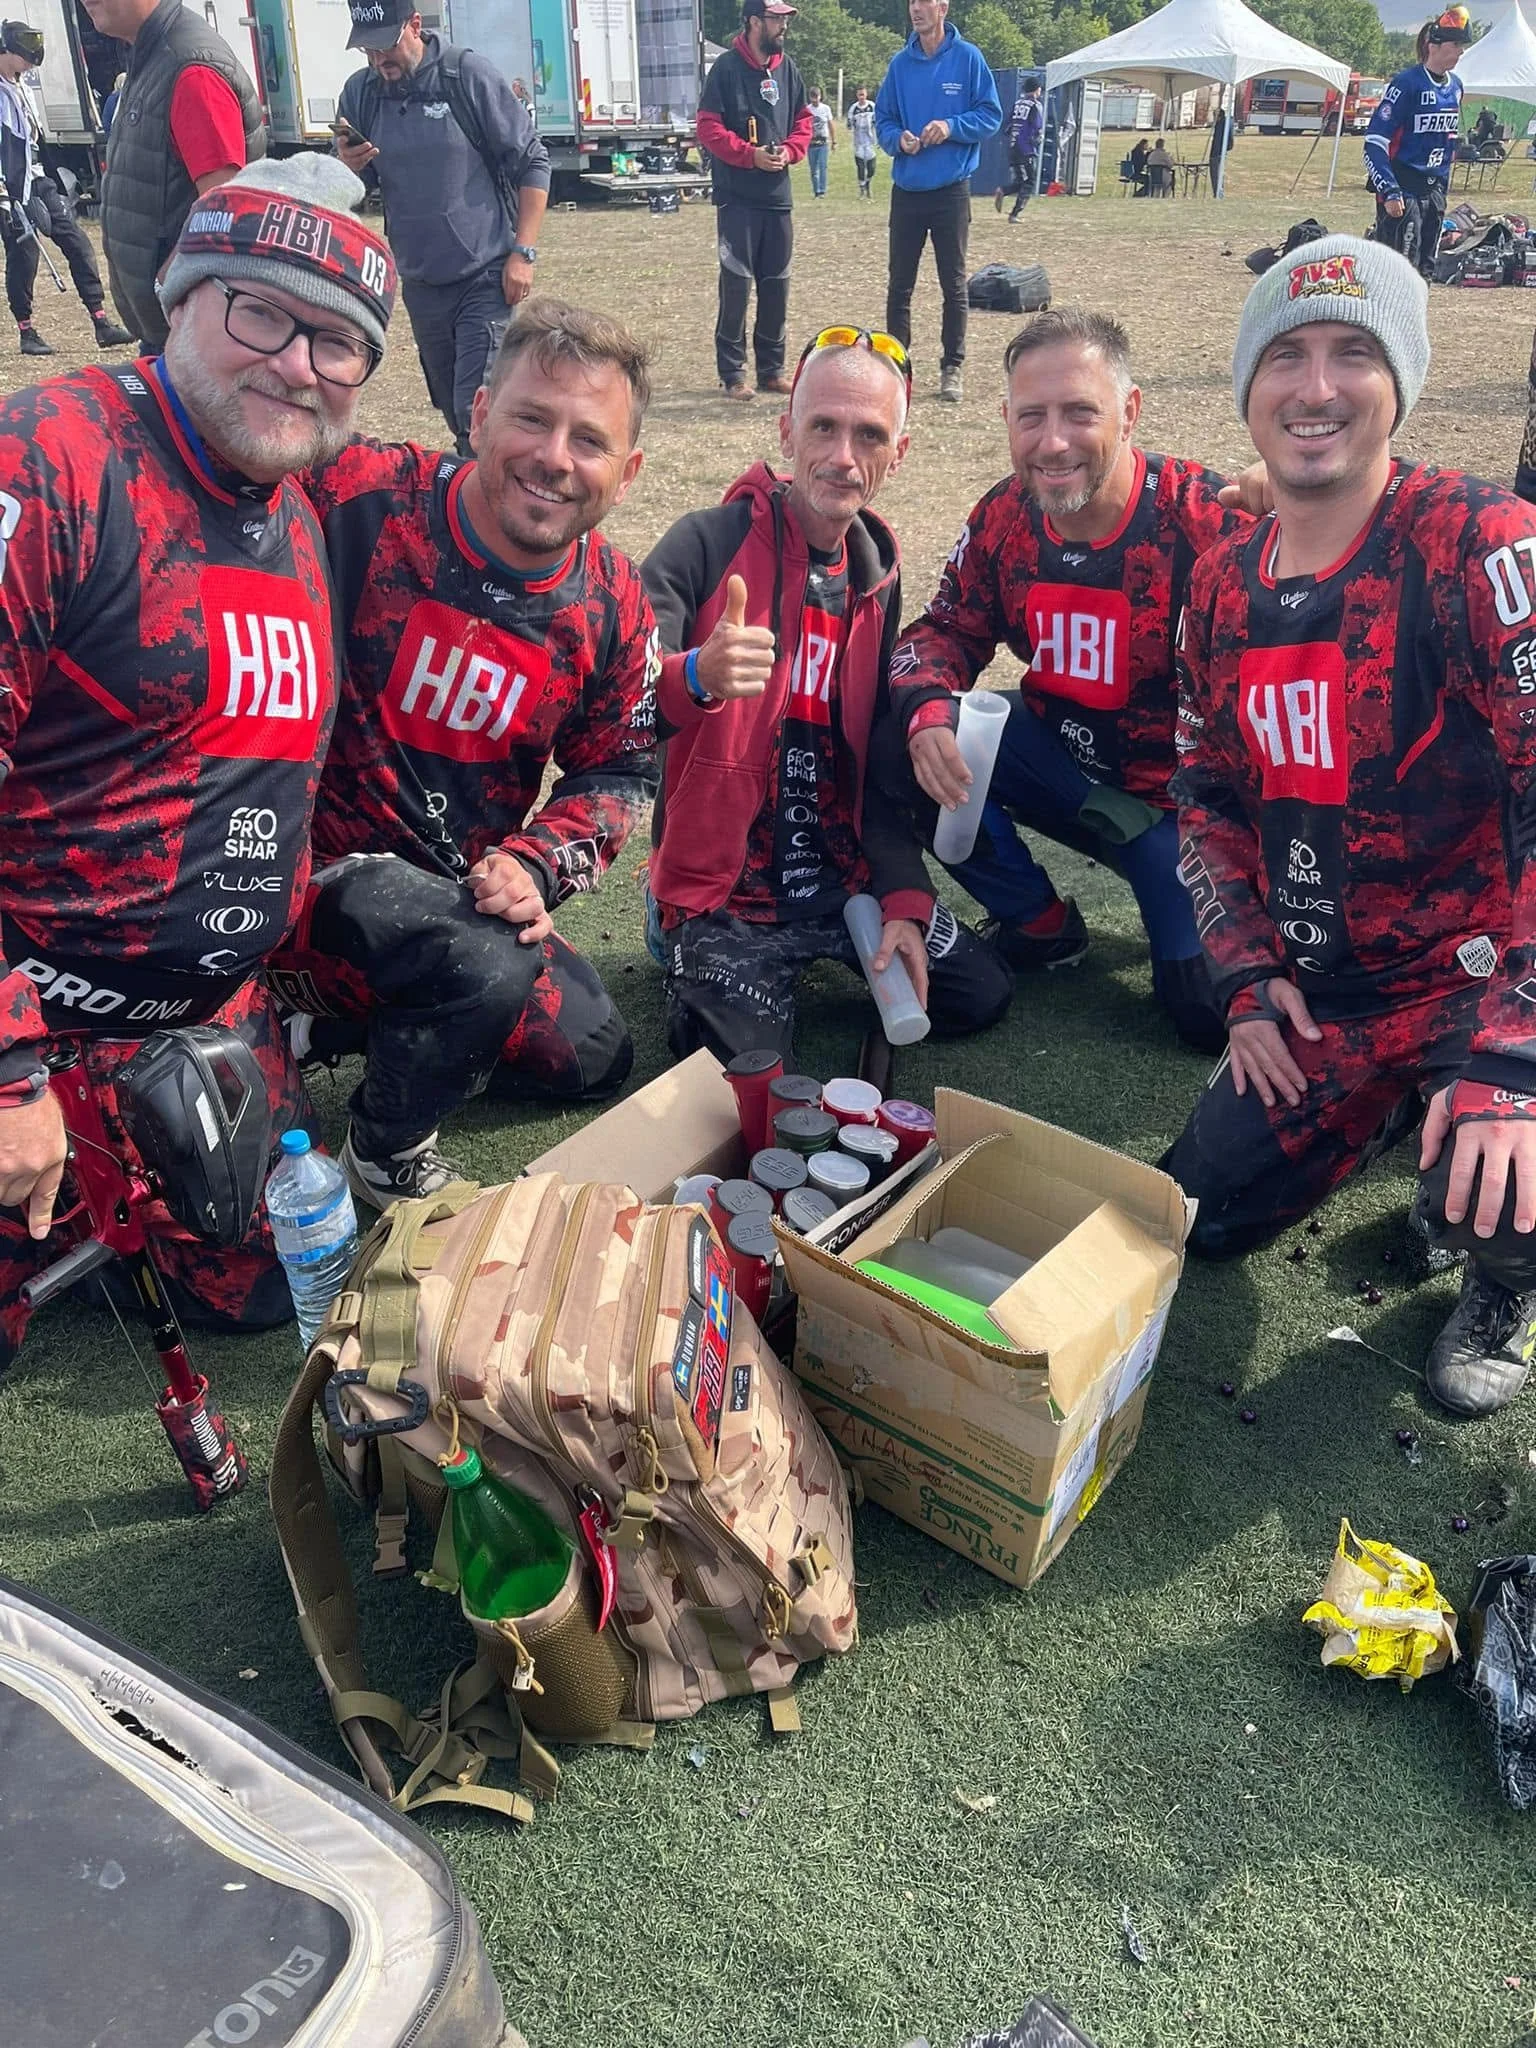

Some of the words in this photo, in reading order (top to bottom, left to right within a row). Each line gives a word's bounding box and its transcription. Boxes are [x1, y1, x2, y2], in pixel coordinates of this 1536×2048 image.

[1421, 91, 1436, 104] 09
[256, 202, 332, 262] HBI
[361, 247, 386, 296] 03
[1289, 255, 1356, 300] JUST
[118, 374, 147, 396] HBI
[1146, 473, 1158, 491] HBI
[222, 612, 318, 720] HBI
[1032, 611, 1116, 685] HBI
[400, 635, 527, 741] HBI
[1247, 679, 1334, 769] HBI
[787, 751, 816, 771] PRO
[787, 766, 816, 783] SHAR
[228, 808, 277, 841] PRO
[224, 839, 278, 860] SHAR
[1290, 842, 1316, 869] PRO
[1287, 864, 1322, 885] SHAR
[11, 958, 126, 1013] PRO
[127, 999, 192, 1020] DNA
[681, 1319, 698, 1363] DUNHAM
[699, 1340, 723, 1410] HBI
[190, 1409, 221, 1461] DUNHAM
[212, 1455, 238, 1494] 03
[920, 1500, 1020, 1575] PRINCE
